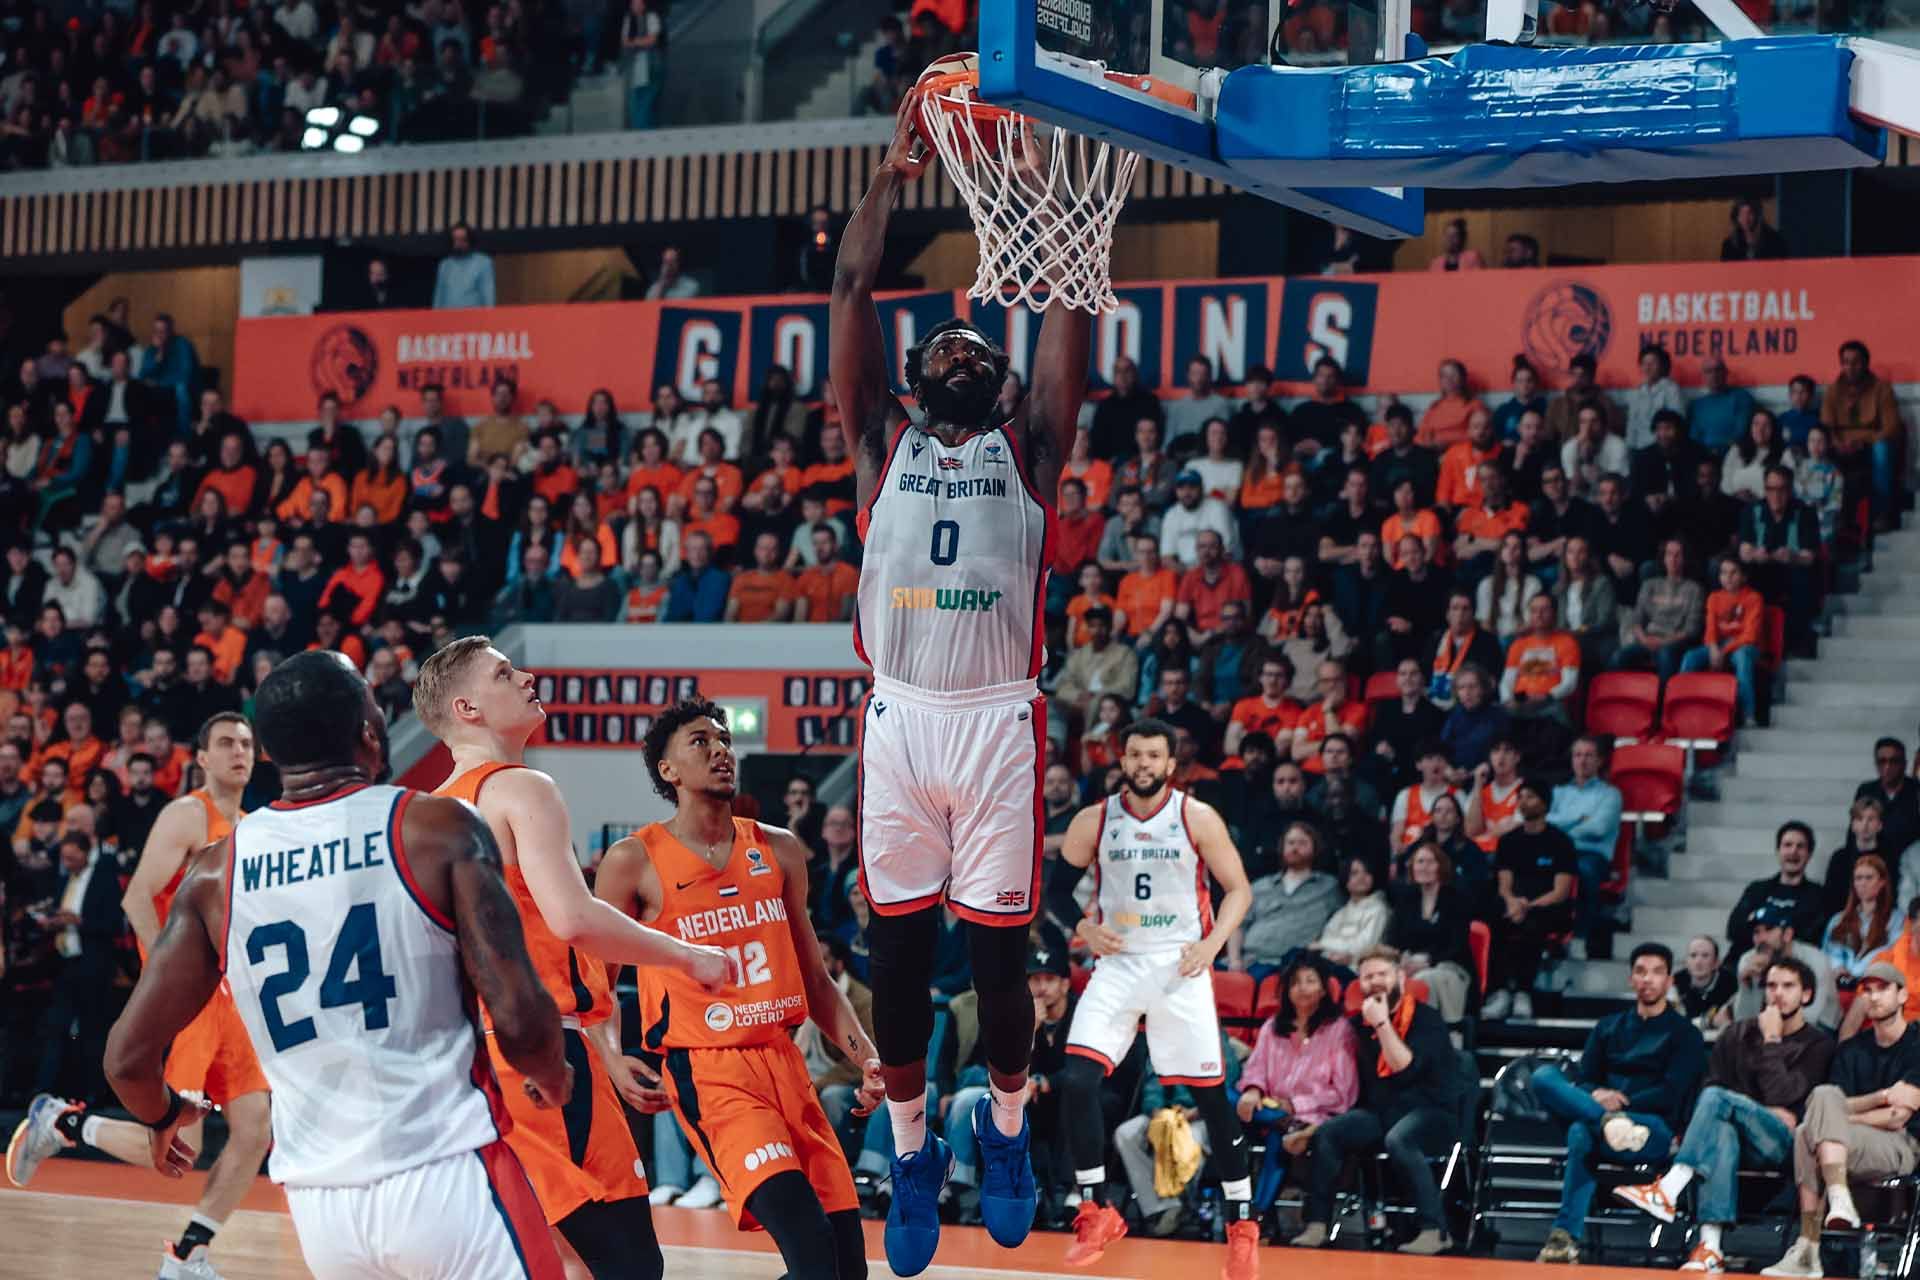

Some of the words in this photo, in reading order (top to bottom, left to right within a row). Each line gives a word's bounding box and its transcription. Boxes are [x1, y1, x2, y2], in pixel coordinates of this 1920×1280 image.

[1638, 288, 1815, 324] BASKETBALL
[397, 331, 534, 363] BASKETBALL
[1639, 328, 1798, 357] NEDERLAND
[899, 473, 943, 497] GREAT
[947, 478, 1007, 499] BRITAIN
[930, 520, 960, 566] 0
[551, 715, 652, 743] LION
[242, 831, 384, 892] WHEATLE
[1108, 849, 1138, 862] GREAT
[1142, 849, 1181, 860] BRITAIN
[1134, 872, 1152, 901] 6
[677, 897, 788, 940] NEDERLAND
[246, 902, 397, 1054] 24
[726, 940, 773, 989] 12
[734, 994, 804, 1015] NEDERLANDSE
[735, 1010, 786, 1028] LOTERIJ
